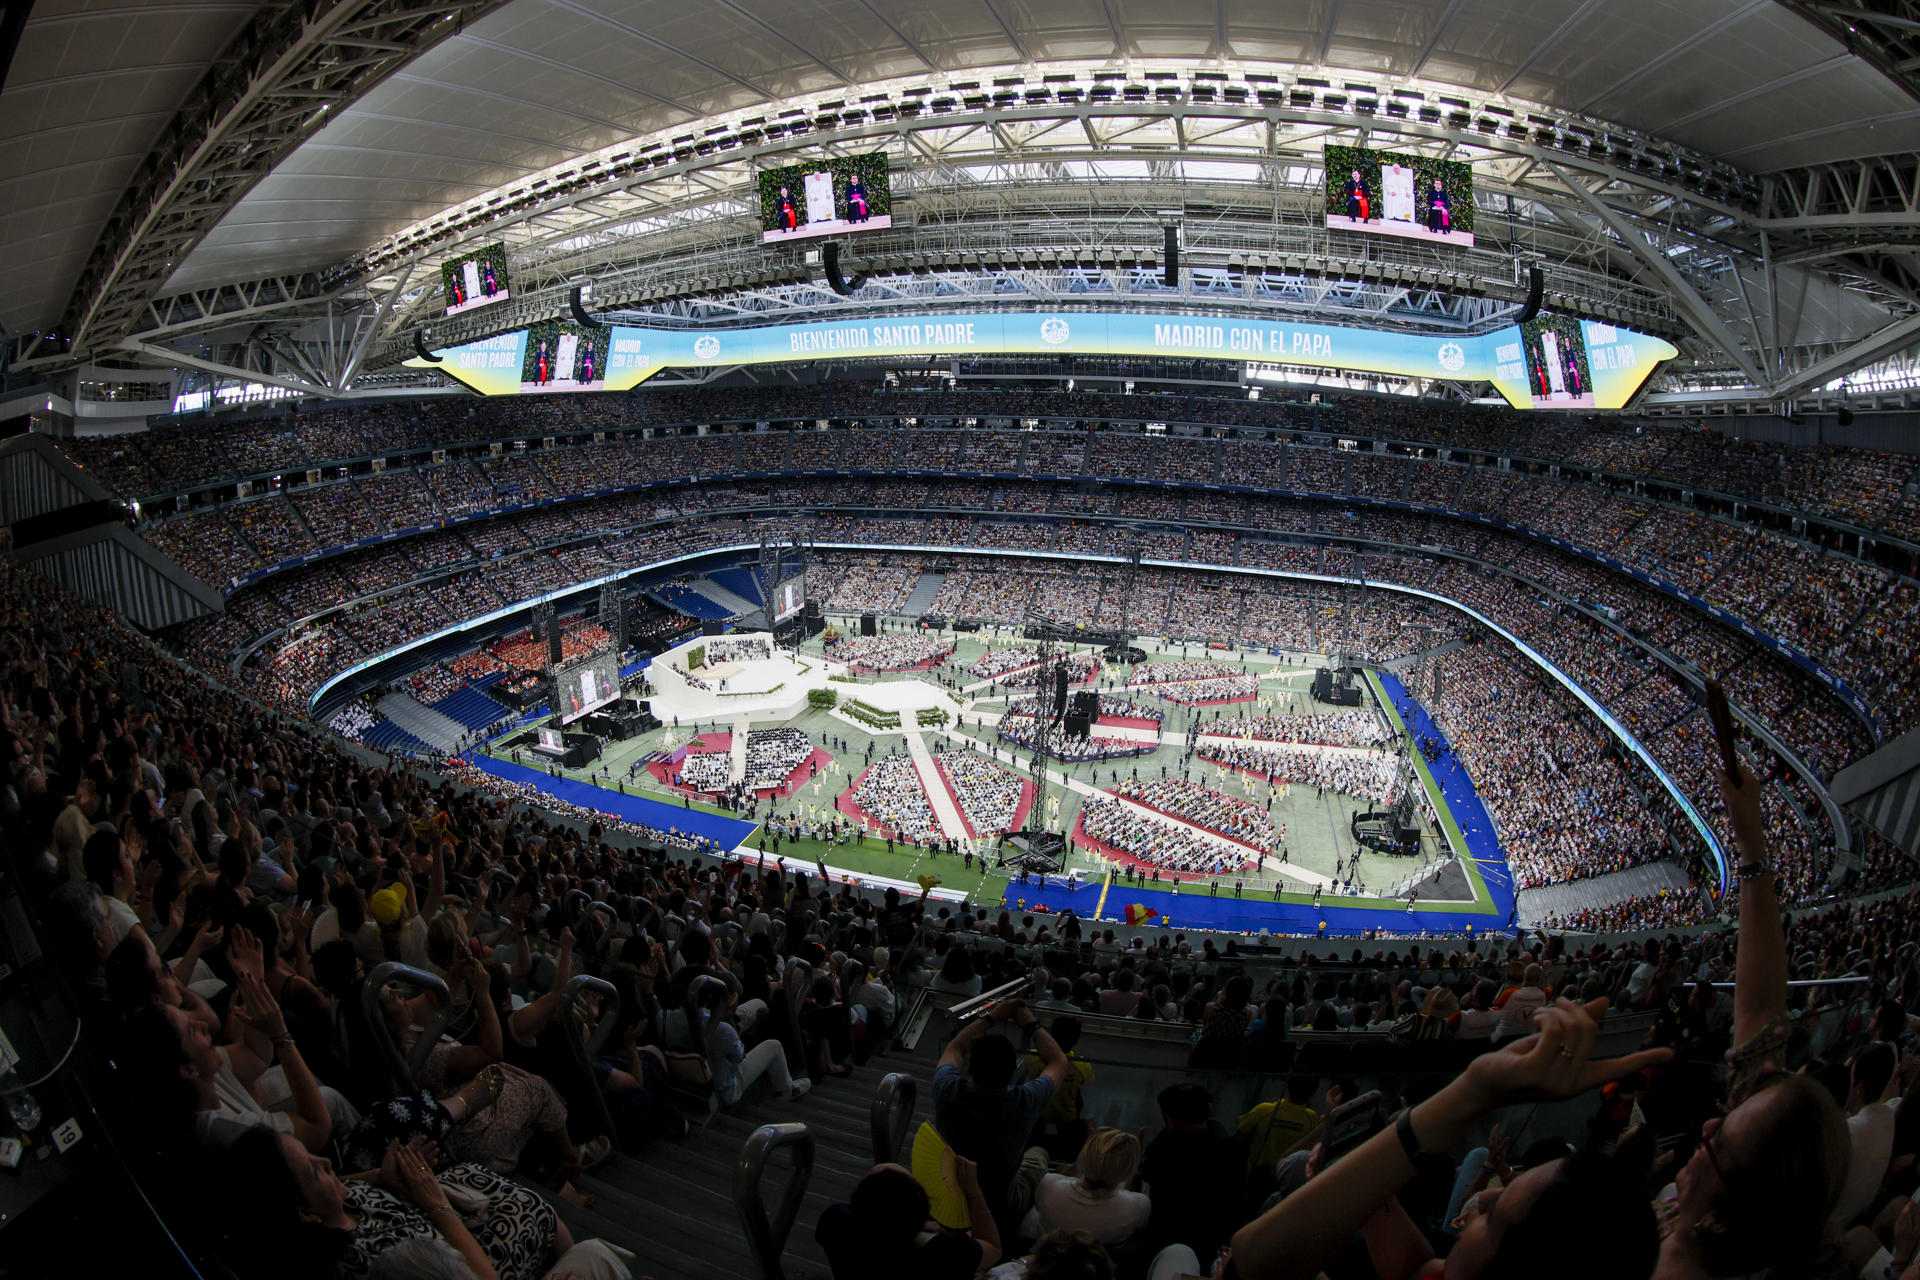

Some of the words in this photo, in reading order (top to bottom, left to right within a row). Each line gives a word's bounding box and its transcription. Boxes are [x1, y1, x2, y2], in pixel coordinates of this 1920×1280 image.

[614, 339, 641, 353] MADRID
[790, 328, 869, 352] BIENVENIDO
[873, 325, 921, 347] SANTO
[925, 323, 975, 345] PADRE
[1154, 324, 1223, 349] MADRID
[1230, 328, 1263, 351] CON
[1270, 330, 1286, 354] EL
[1293, 332, 1332, 357] PAPA
[459, 351, 488, 368] SANTO
[488, 351, 516, 368] PADRE
[612, 353, 626, 368] CON
[60, 1125, 76, 1144] 19
